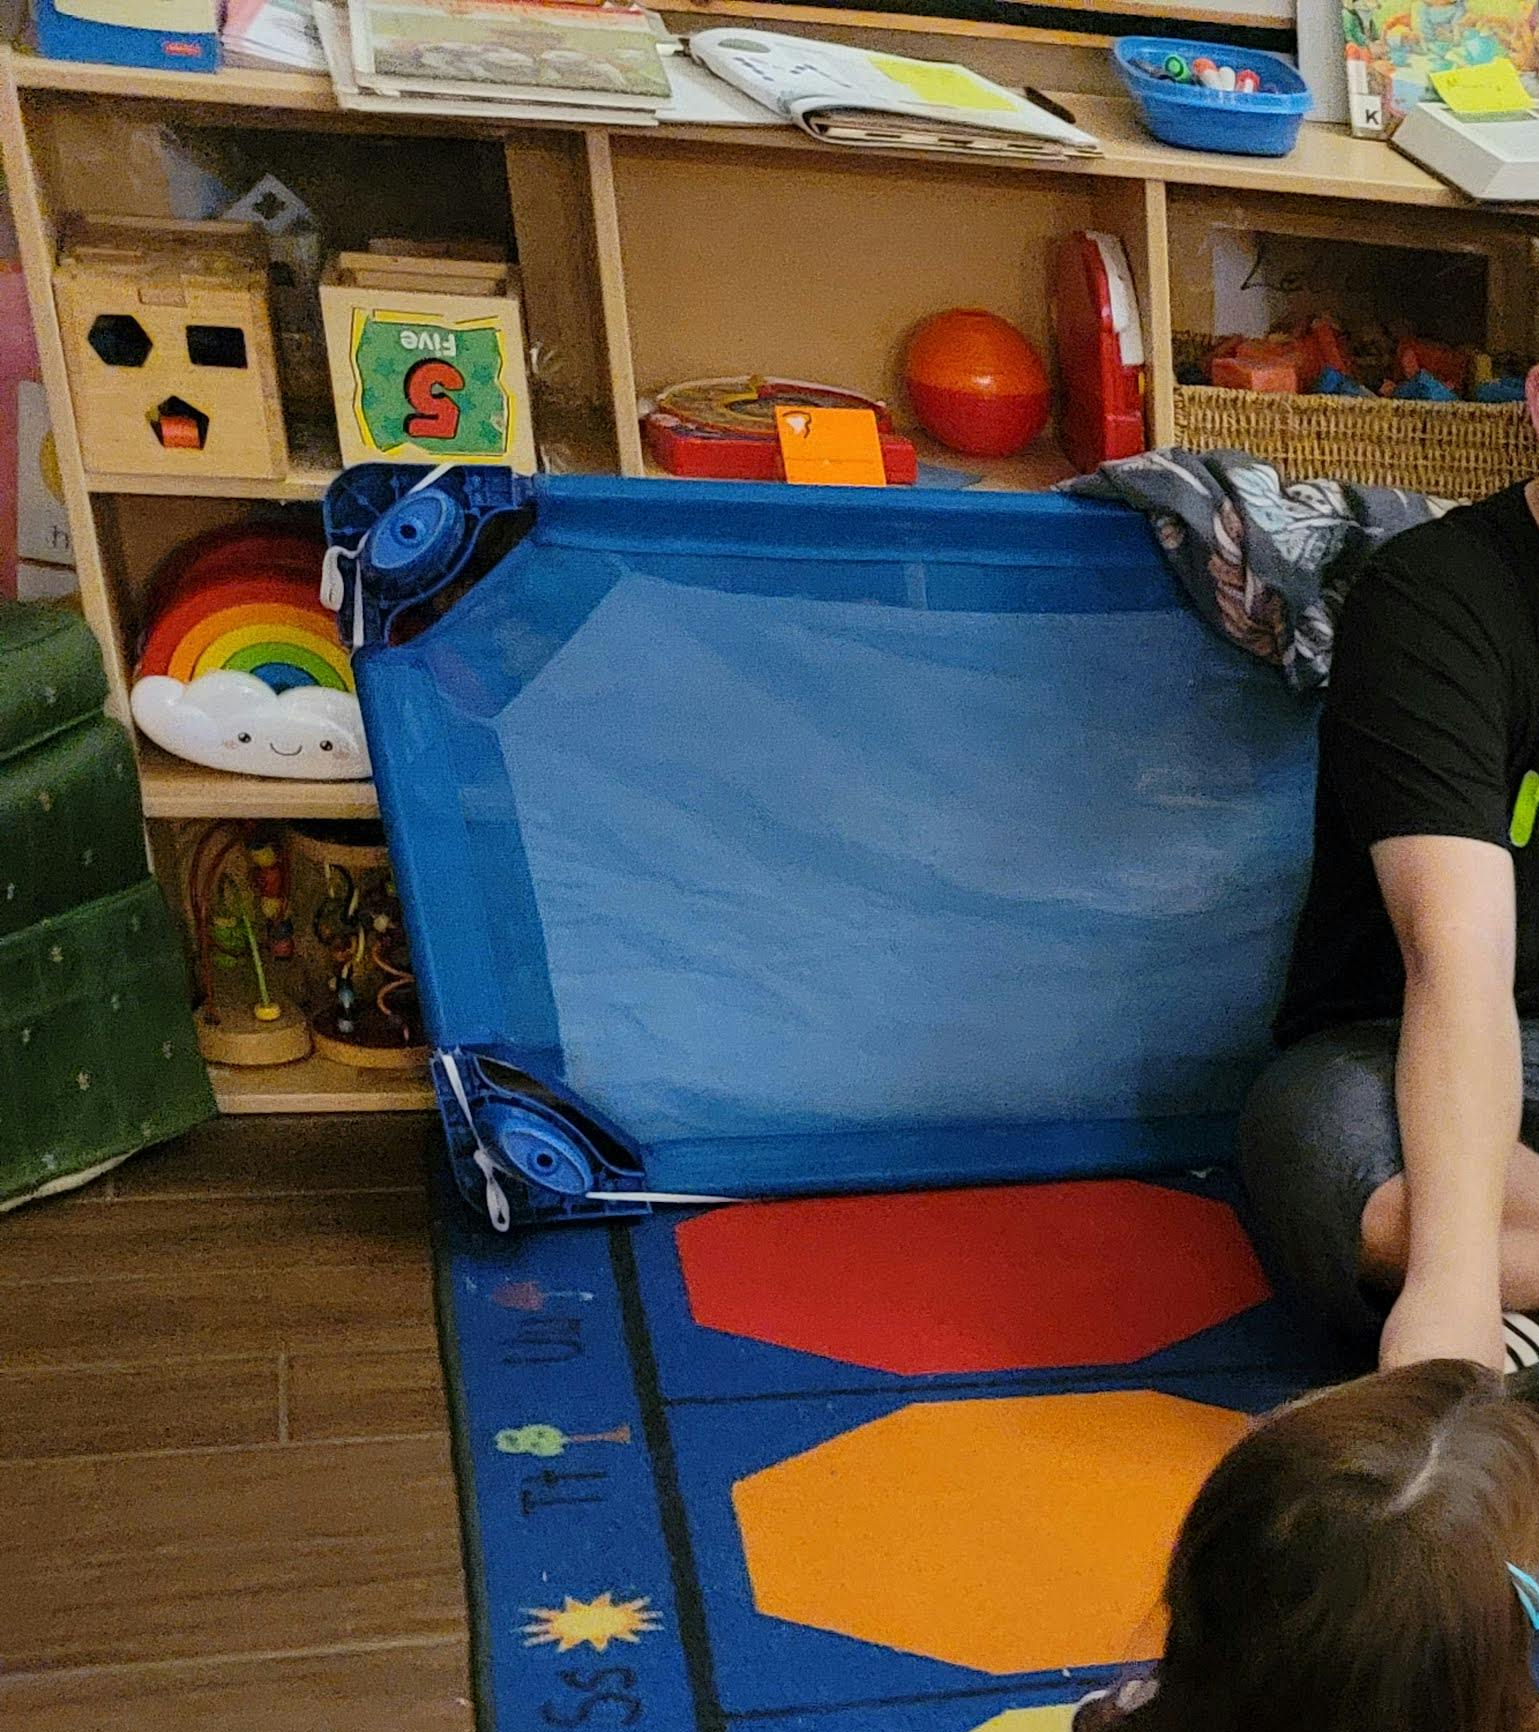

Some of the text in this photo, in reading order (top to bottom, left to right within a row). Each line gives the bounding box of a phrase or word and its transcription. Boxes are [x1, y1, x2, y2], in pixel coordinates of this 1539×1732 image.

[1365, 109, 1380, 126] K
[400, 330, 457, 358] Five
[403, 357, 466, 440] 5
[539, 1664, 645, 1728] Ss
